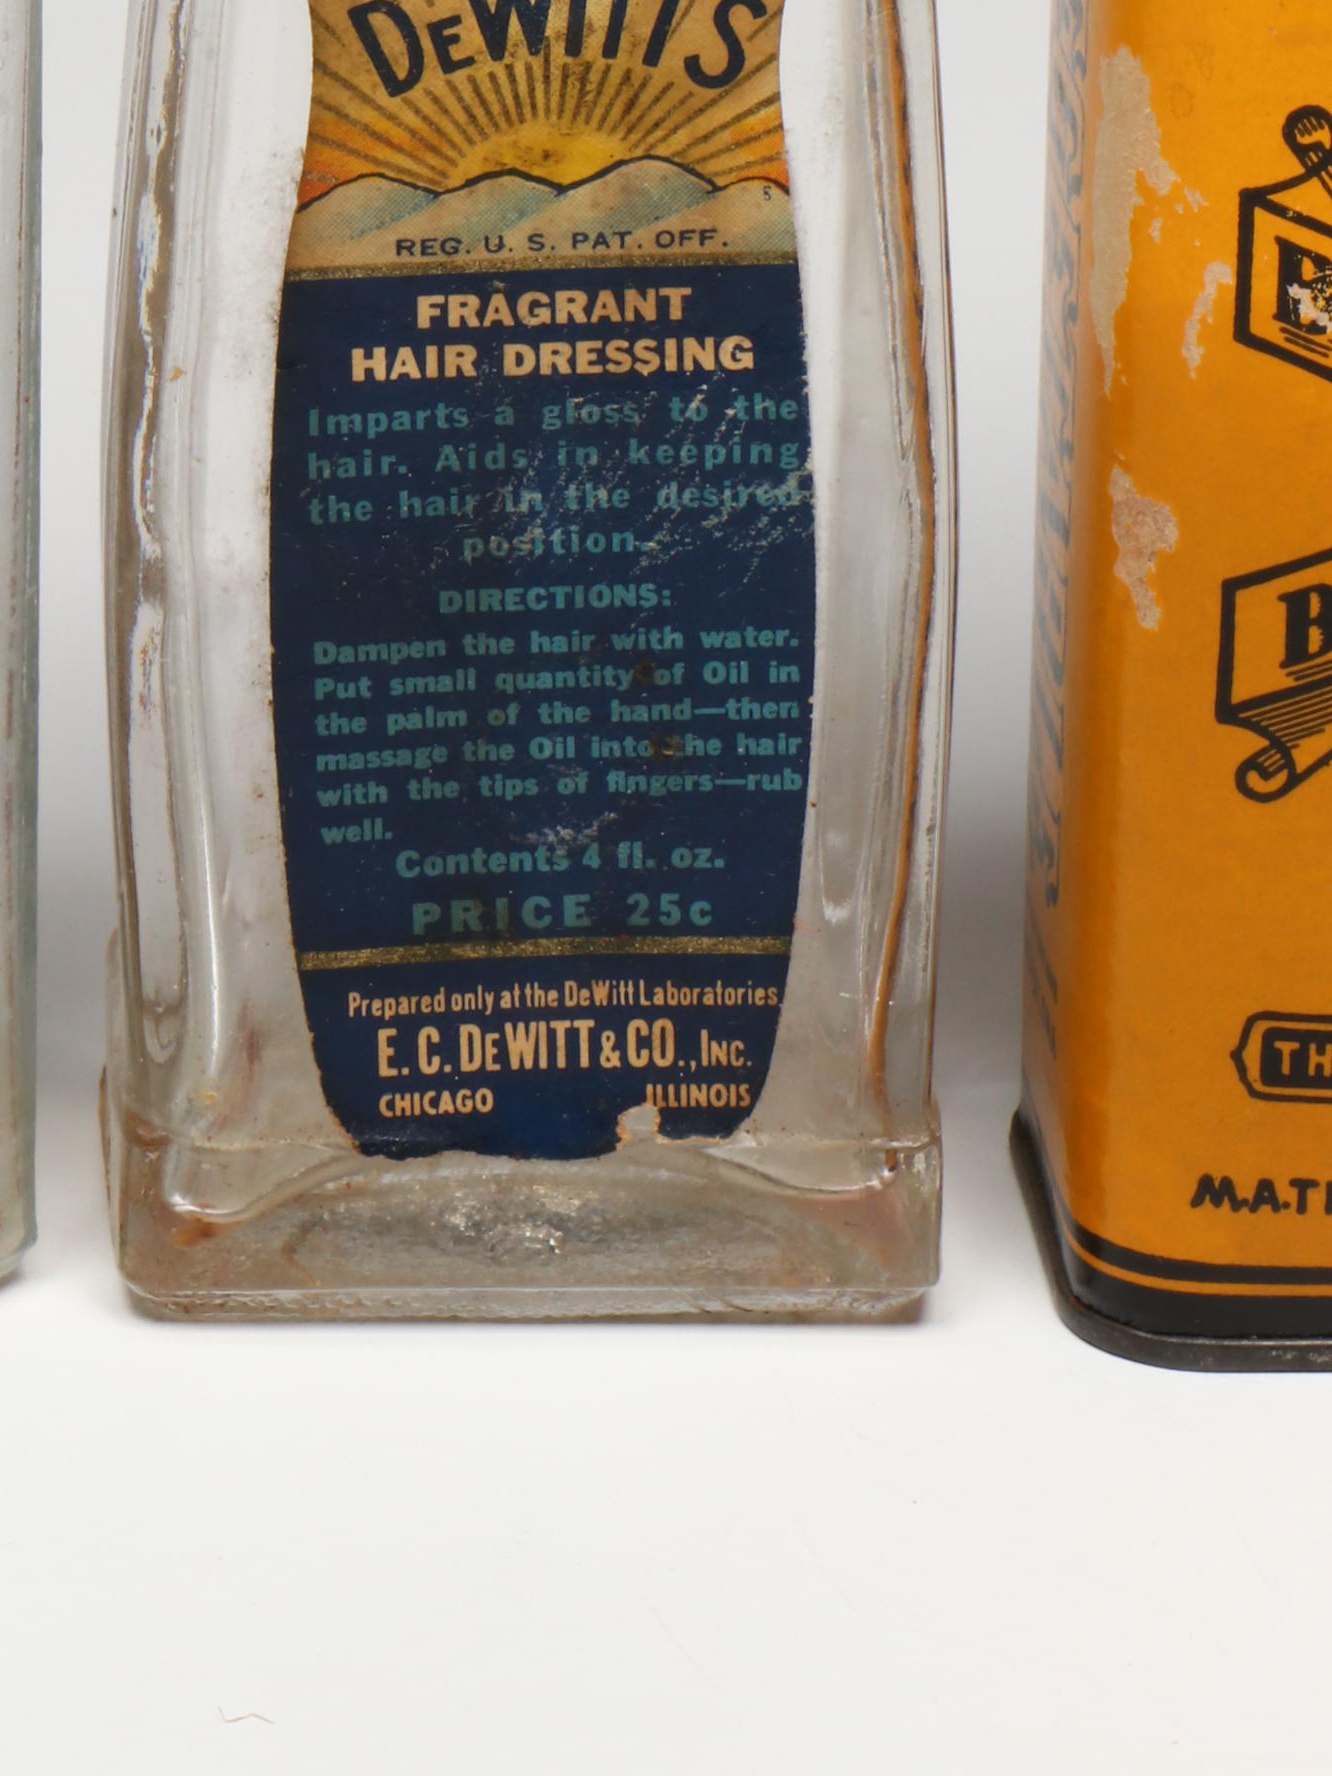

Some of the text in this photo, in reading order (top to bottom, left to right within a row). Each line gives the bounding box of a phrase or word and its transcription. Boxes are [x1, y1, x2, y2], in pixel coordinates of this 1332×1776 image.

[395, 229, 729, 256] REG. U. S. PAT. OFF.
[416, 287, 692, 329] FRAGRANT
[351, 335, 754, 382] HAIR DRESSING
[308, 392, 799, 439] Imparts a gloss to the
[307, 437, 800, 480] hair. Aids in keeping
[308, 480, 800, 525] the hair in the desired
[463, 524, 650, 564] position.
[439, 584, 672, 614] DIRECTIONS:
[313, 626, 800, 665] Dampen the hair with water.
[313, 661, 800, 700] Put small quantity of Oil in
[314, 713, 368, 735] the
[387, 705, 468, 734] palm
[486, 703, 520, 726] of
[537, 701, 591, 724] the
[316, 744, 449, 773] massage
[463, 737, 516, 759] the
[529, 734, 576, 759] Oil
[591, 734, 653, 757] into
[736, 732, 802, 756] hair
[316, 784, 389, 808] with
[407, 776, 460, 799] the
[479, 773, 539, 801] tips
[557, 770, 589, 795] of
[319, 818, 393, 845] well.
[395, 840, 725, 879] Contents 4 fl. oz.
[412, 892, 712, 935] PRICE 25c
[348, 986, 446, 1020] Prepared
[451, 984, 494, 1015] only
[500, 982, 520, 1009] at
[525, 981, 558, 1008] the
[564, 979, 634, 1007] DeWitt
[379, 1083, 751, 1117] CHICAGO ILLINOIS
